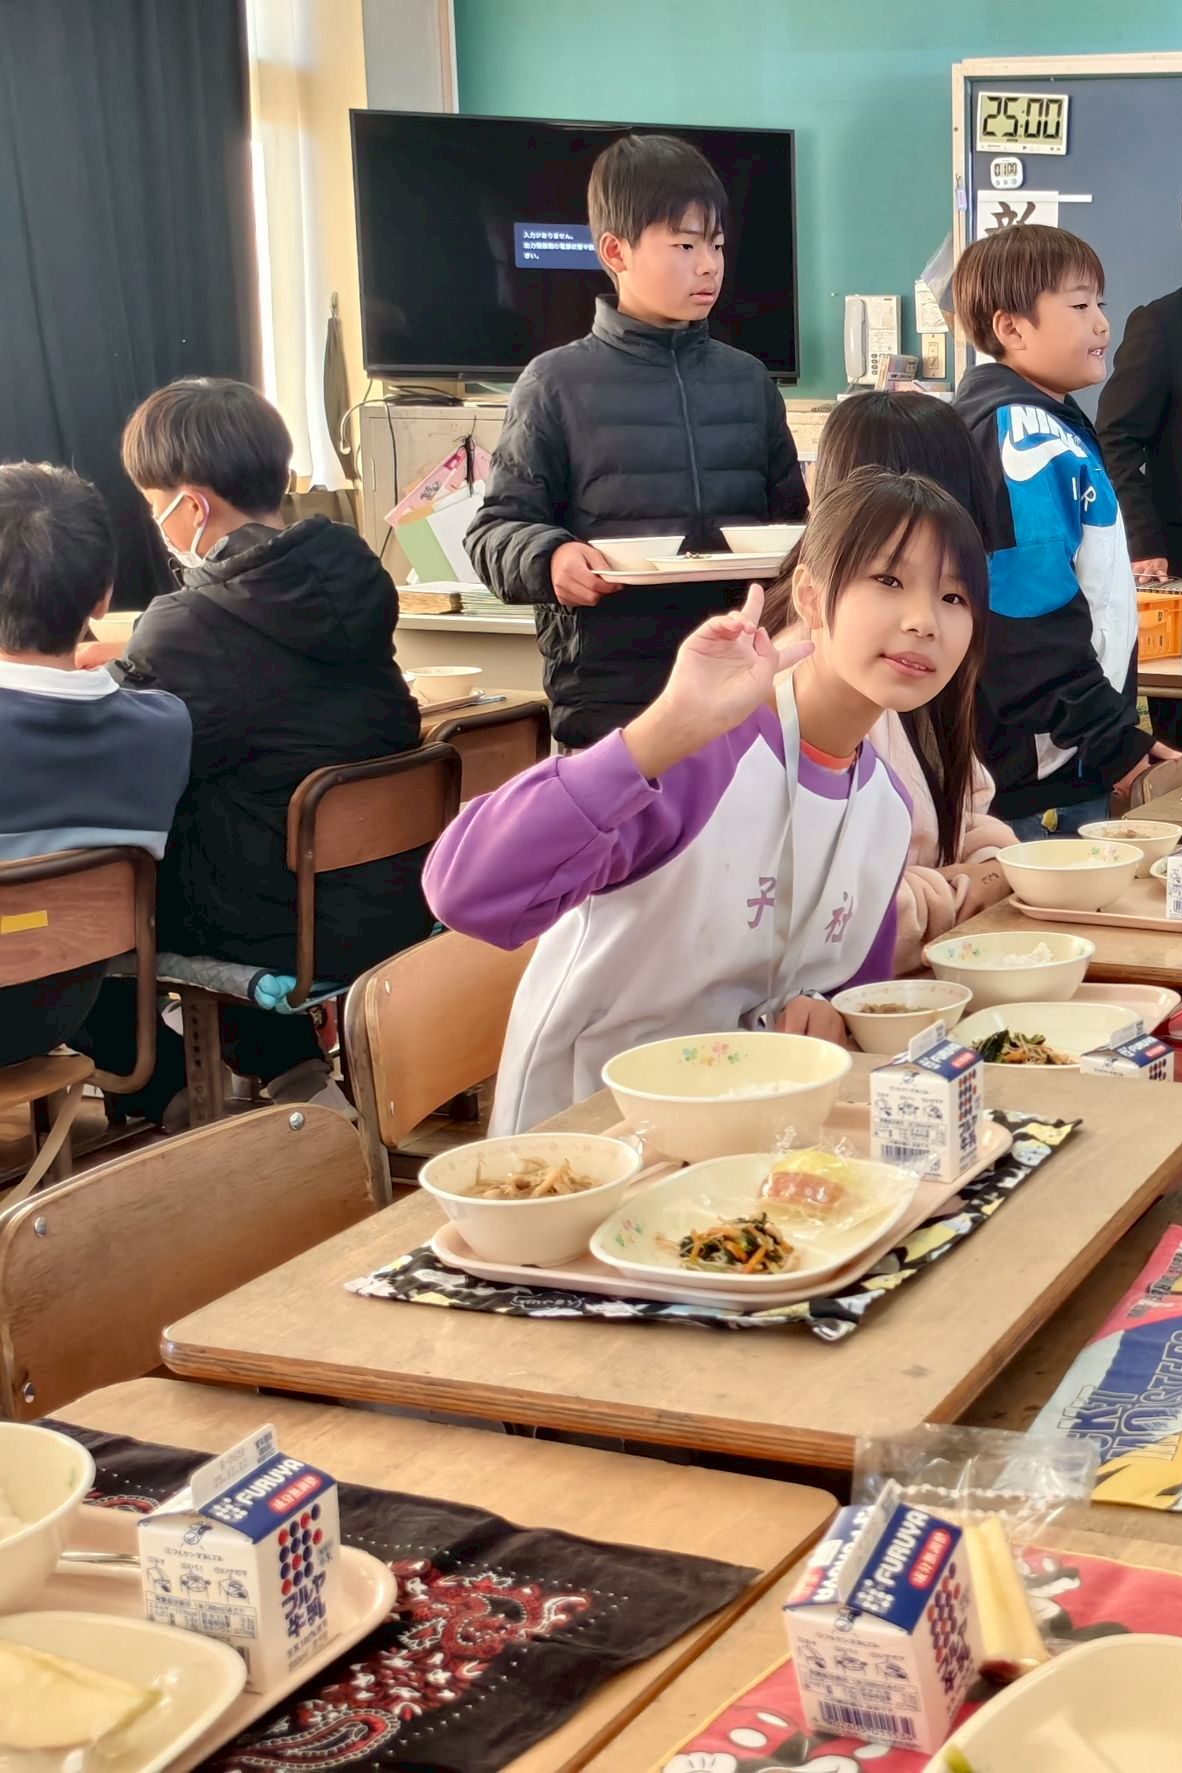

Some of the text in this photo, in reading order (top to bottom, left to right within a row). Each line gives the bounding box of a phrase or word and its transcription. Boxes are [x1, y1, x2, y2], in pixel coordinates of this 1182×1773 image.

[983, 96, 1063, 139] 25:00
[235, 1457, 305, 1506] FURUYA
[873, 1508, 930, 1588] FURUYA
